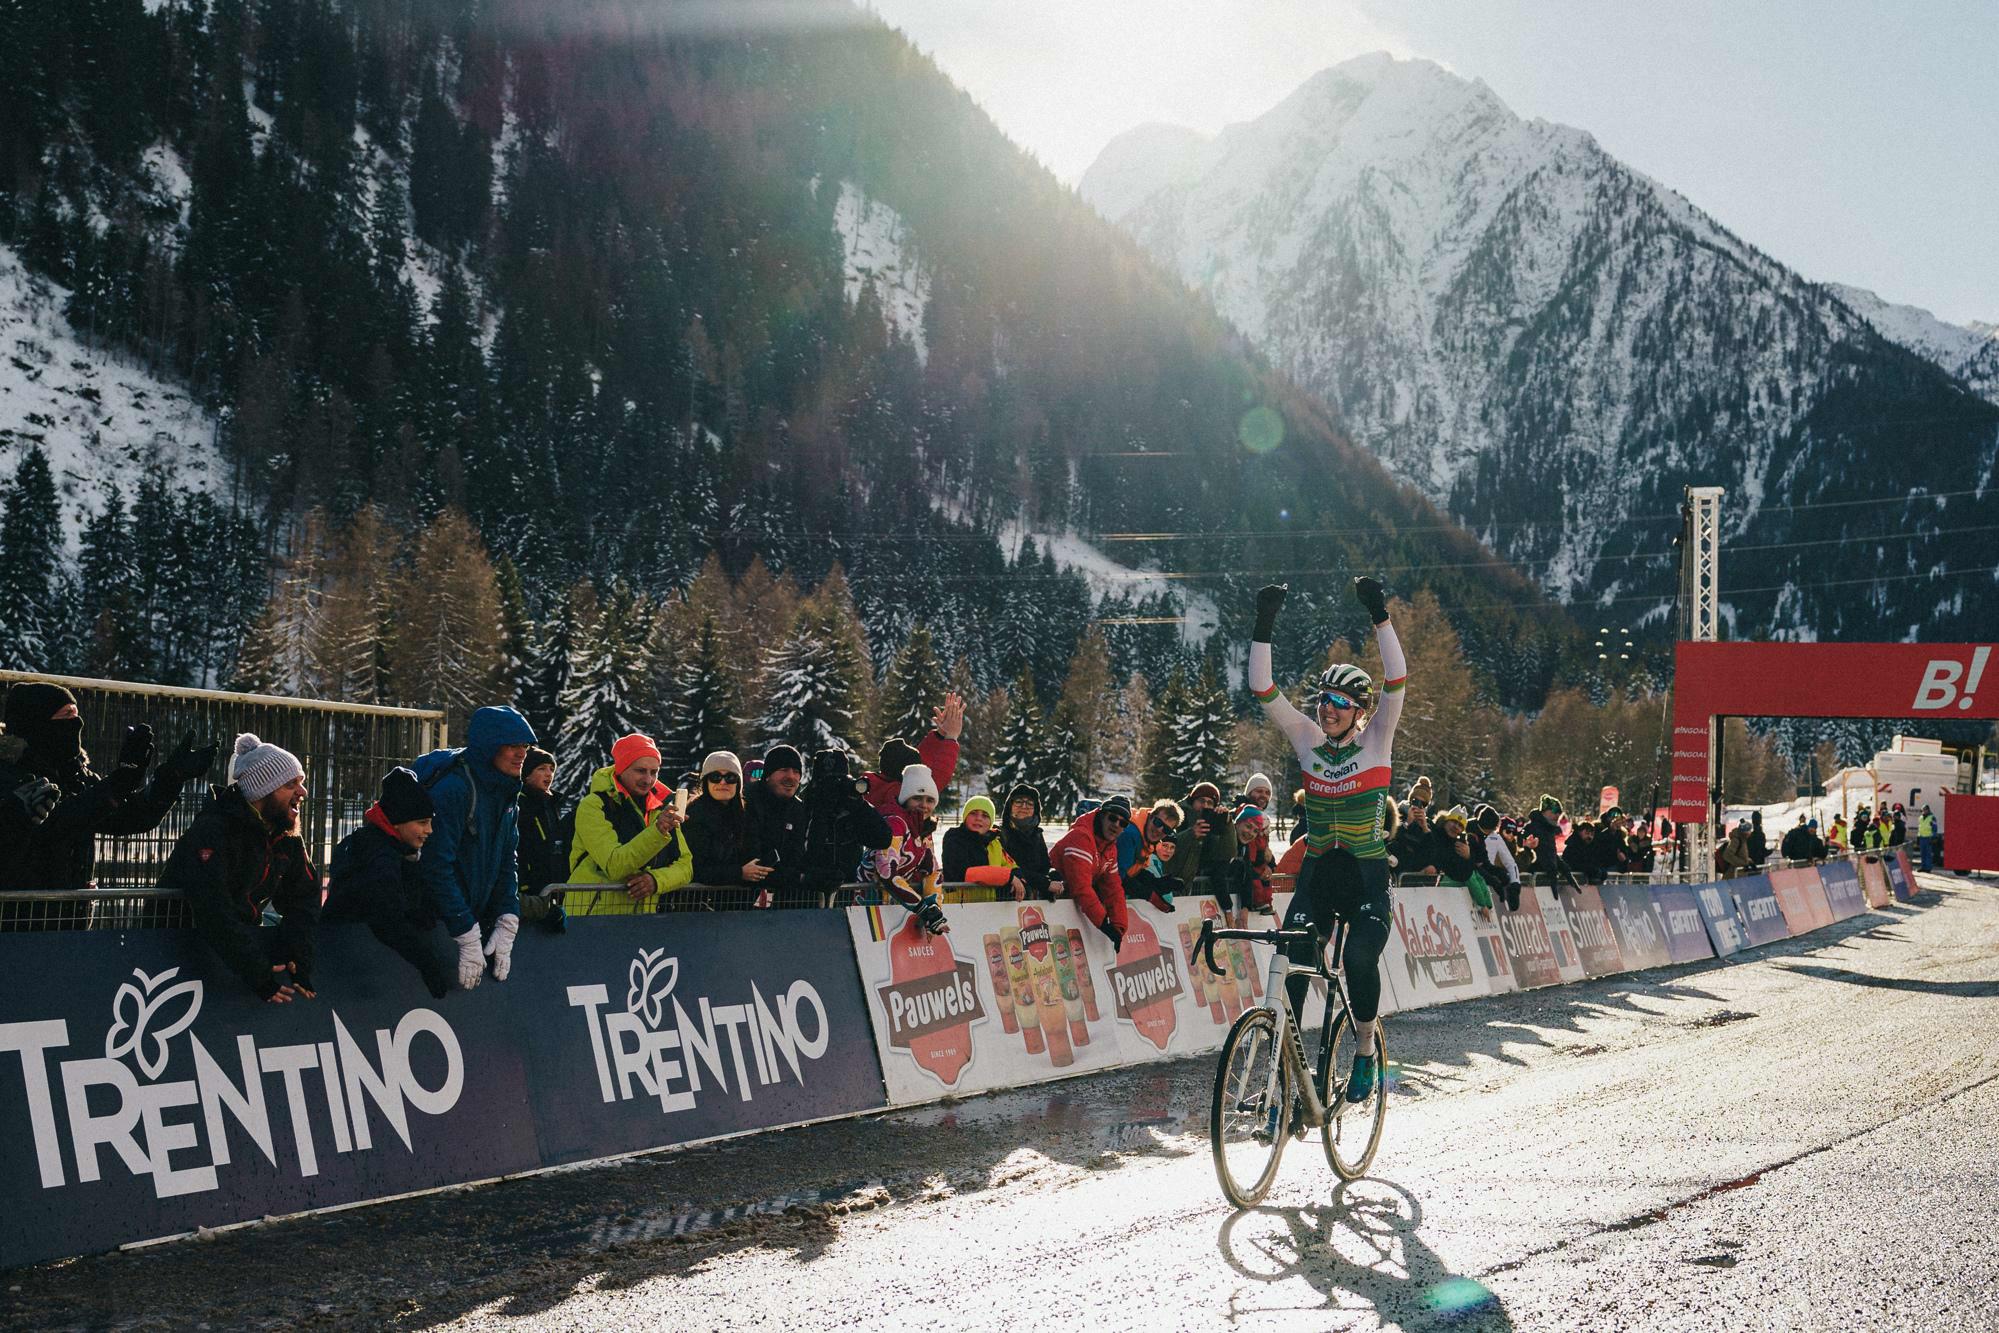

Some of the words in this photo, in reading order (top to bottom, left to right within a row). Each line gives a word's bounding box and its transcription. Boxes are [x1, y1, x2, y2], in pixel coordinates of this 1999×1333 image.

[1912, 646, 1992, 710] B!
[908, 946, 935, 958] SAUCES
[1126, 933, 1146, 944] SAUCES
[566, 979, 830, 1113] TRENTINO
[1284, 1007, 1309, 1071] STEVENS
[0, 1009, 465, 1198] TRENTINO
